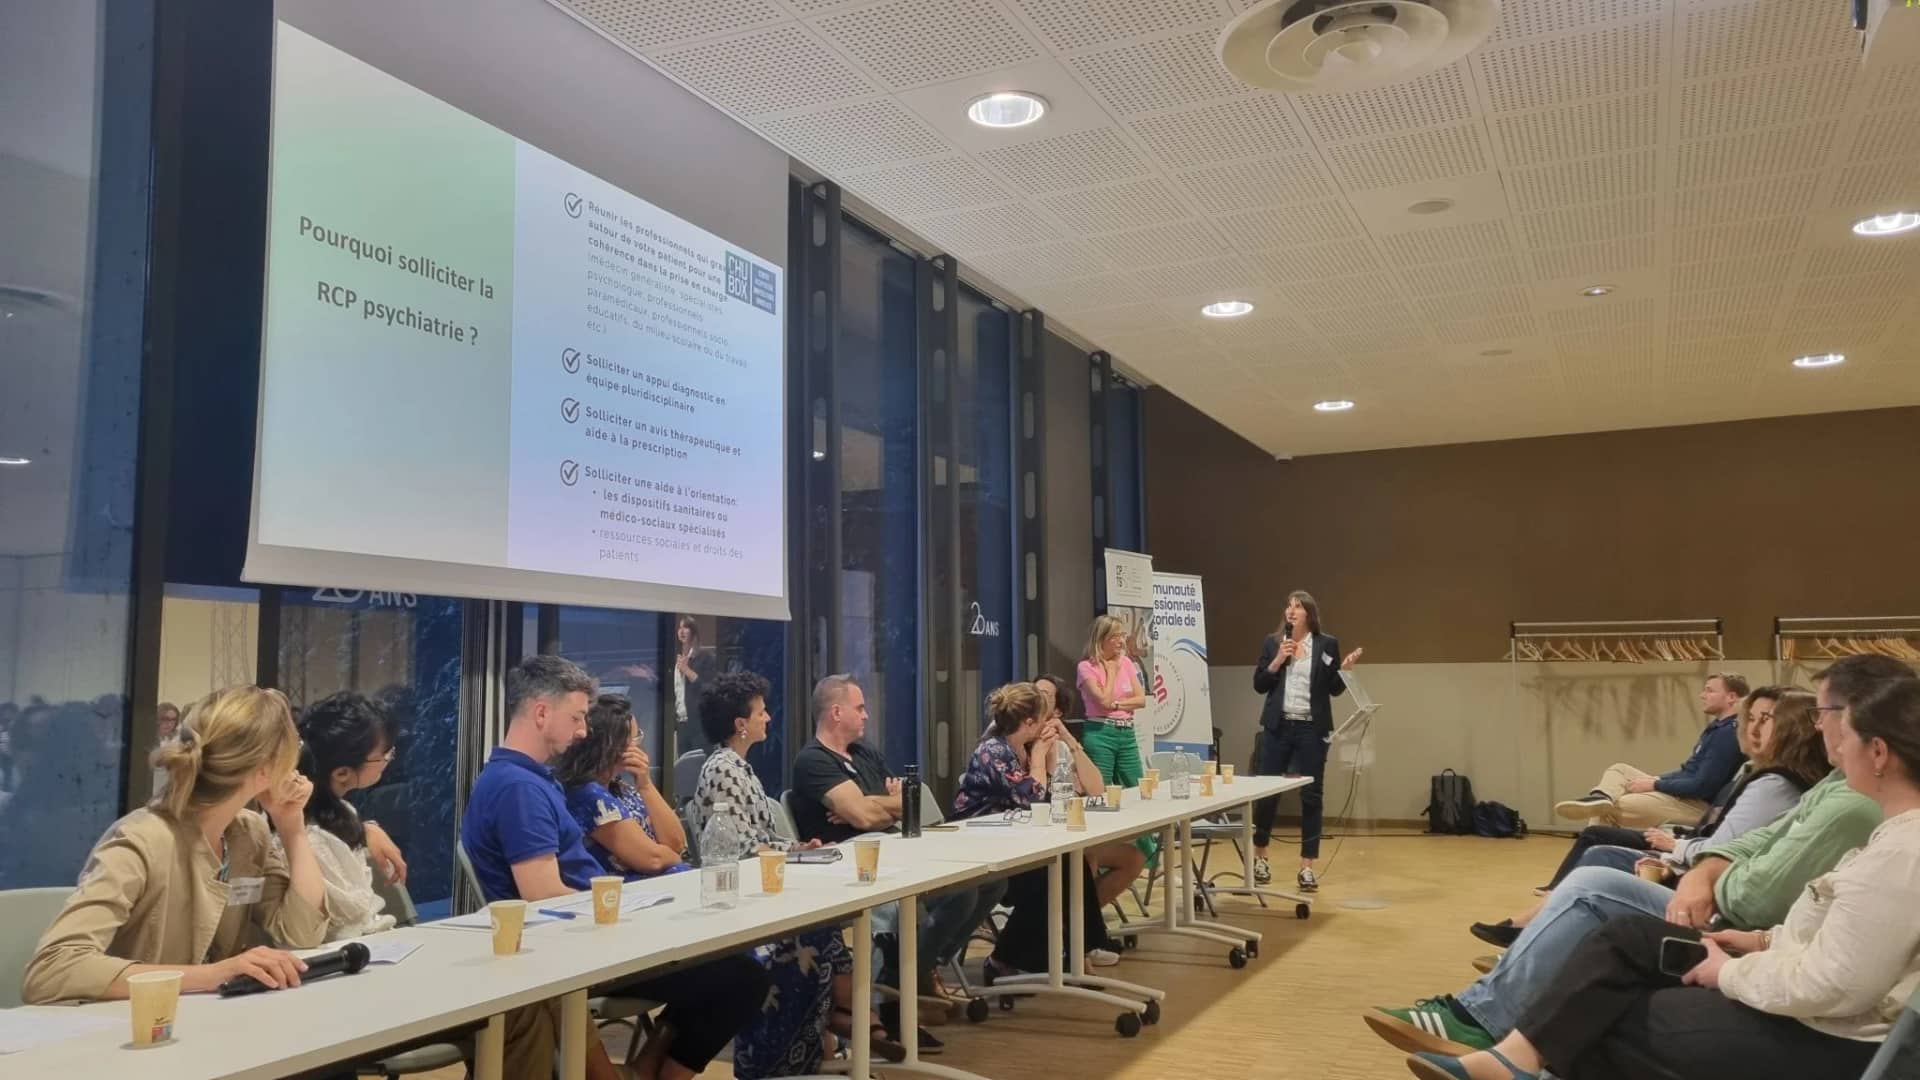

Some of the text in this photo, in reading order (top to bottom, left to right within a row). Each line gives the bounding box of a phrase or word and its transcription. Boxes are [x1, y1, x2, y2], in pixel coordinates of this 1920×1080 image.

[588, 200, 618, 221] Réunir
[620, 216, 633, 230] les
[635, 225, 695, 258] professionnels
[696, 254, 709, 265] qui
[299, 215, 494, 299] Pourquoi solliciter la
[588, 220, 721, 285] autour de votre patient pour une
[588, 237, 728, 302] cohérence dans la prise en charge
[728, 255, 748, 280] CHU
[317, 281, 479, 346] RCP psychiatrie ?
[632, 319, 643, 331] du
[672, 334, 702, 351] scolaire
[703, 346, 713, 356] ou
[714, 350, 724, 360] du
[586, 353, 726, 406] Solliciter un appui diagnostic en
[586, 372, 695, 414] équipe pluridisciplinaire
[585, 406, 742, 456] Solliciter un avis thérapeutique et
[585, 427, 688, 459] aide à la prescription
[585, 466, 632, 485] Solliciter
[634, 478, 652, 489] une
[655, 481, 675, 494] aide
[677, 485, 683, 495] à
[603, 489, 728, 522] les dispositifs sanitaires ou
[600, 528, 743, 559] ressources sociales et droits des
[678, 522, 726, 539] spécialisés
[599, 548, 640, 562] patients
[970, 601, 1000, 637] 20 ANS
[1154, 596, 1201, 612] ssionnelle
[1184, 613, 1196, 626] de
